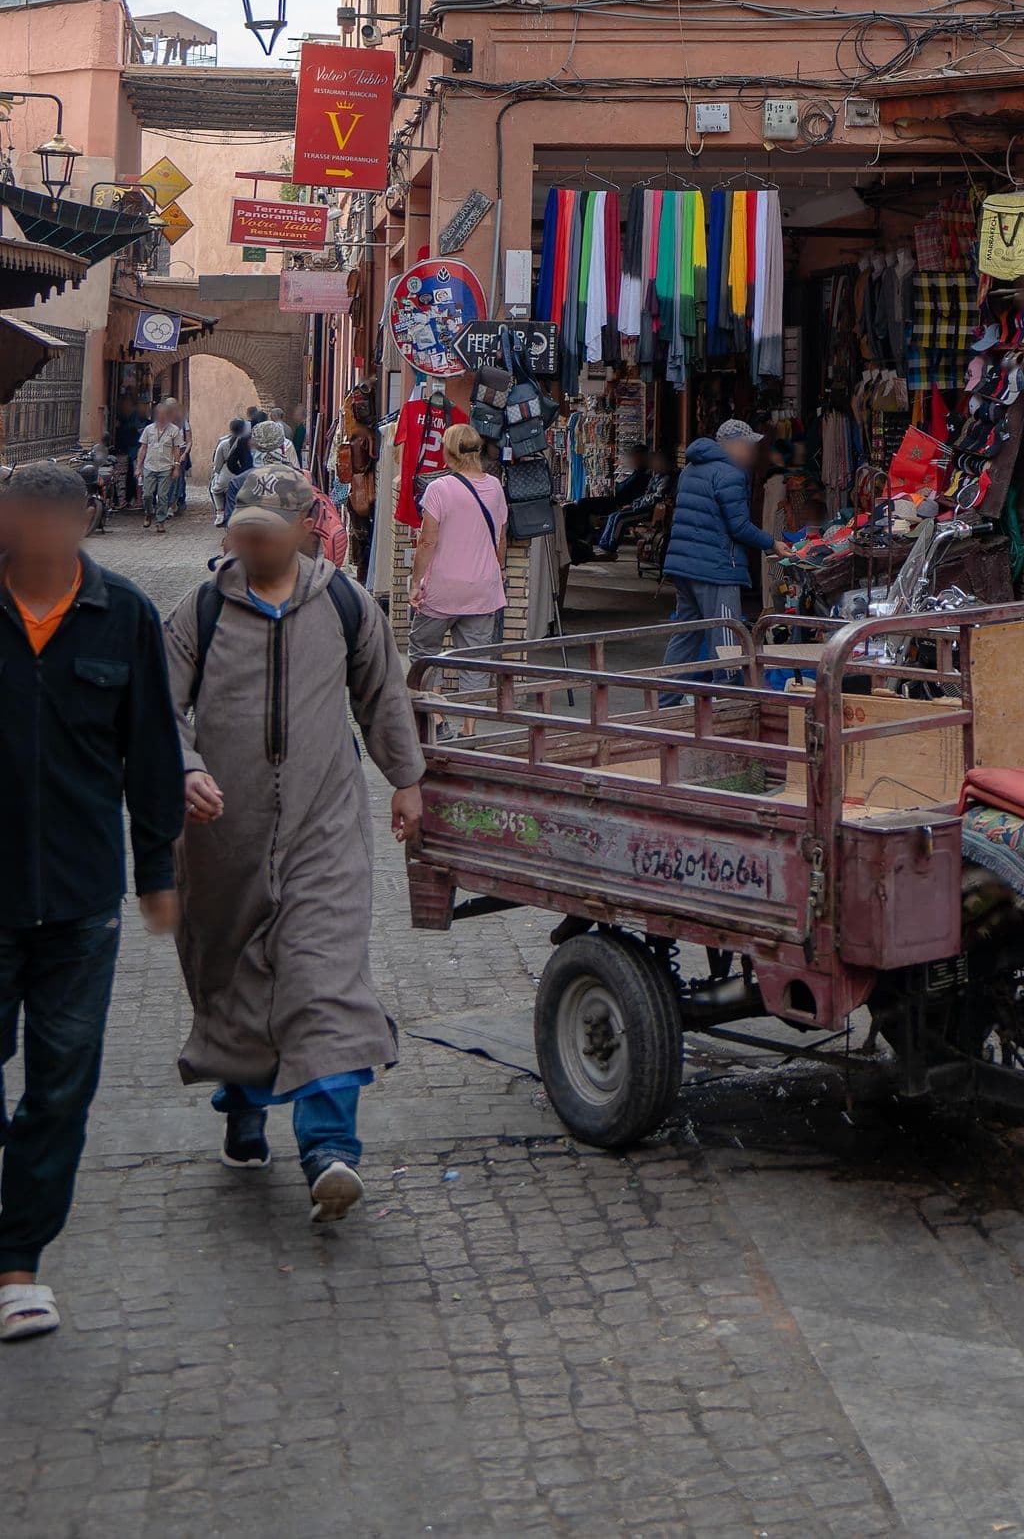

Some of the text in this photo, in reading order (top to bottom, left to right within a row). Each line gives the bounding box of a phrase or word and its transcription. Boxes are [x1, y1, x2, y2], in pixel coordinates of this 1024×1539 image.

[306, 64, 389, 86] Votre Table
[313, 87, 378, 99] RESTAURANT MAROCAIN
[303, 152, 380, 164] TERASSE PANORAMIQUE
[237, 209, 322, 224] Panoramique
[254, 204, 306, 216] Terrasse
[238, 216, 322, 233] Votre Table
[250, 228, 308, 239] Restaurant
[986, 215, 998, 261] MARRAKECH
